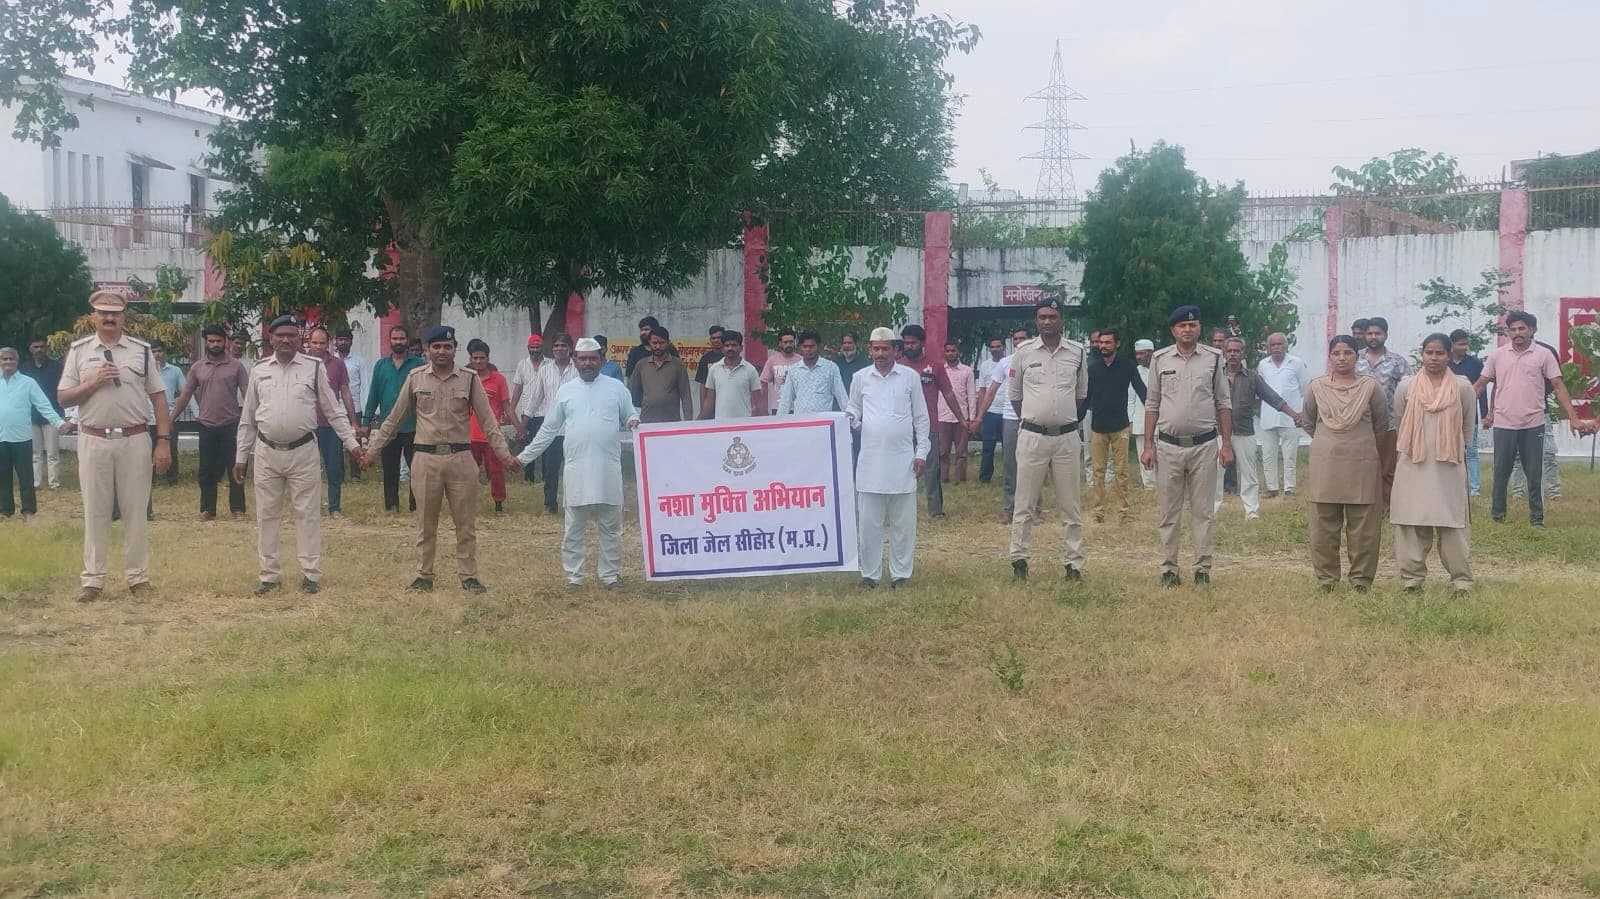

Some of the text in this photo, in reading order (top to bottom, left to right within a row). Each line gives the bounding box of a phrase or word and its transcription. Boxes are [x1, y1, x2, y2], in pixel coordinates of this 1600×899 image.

[1006, 285, 1042, 301] मनोरंजन
[658, 482, 826, 523] नशा मुक्ति अभियान
[661, 523, 829, 556] जिला जेल सीहोर (म.प्र.)
